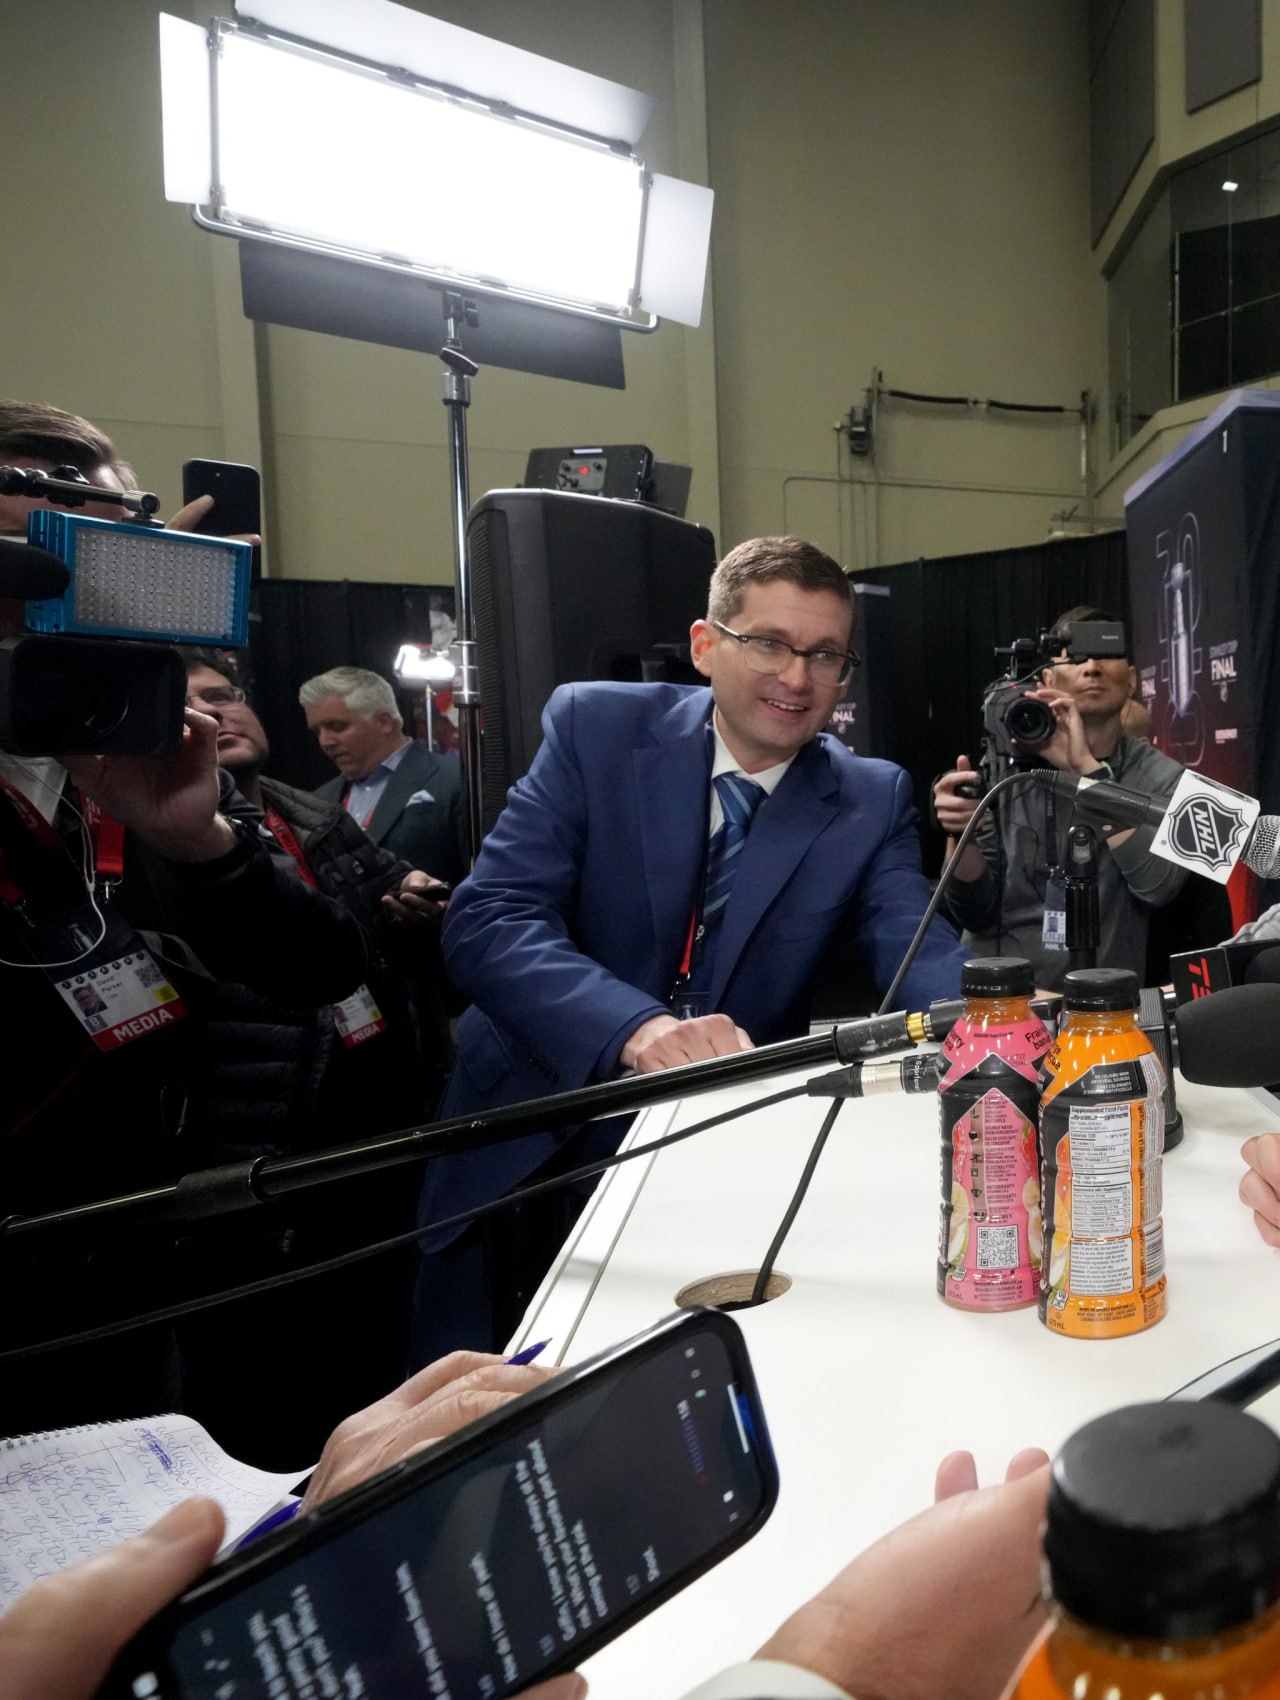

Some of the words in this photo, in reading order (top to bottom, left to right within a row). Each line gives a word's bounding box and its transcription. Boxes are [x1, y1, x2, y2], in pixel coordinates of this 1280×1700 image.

[1211, 655, 1237, 681] FINAL
[1193, 807, 1216, 853] NHL
[112, 1008, 175, 1042] MEDIA
[351, 1022, 381, 1044] MEDIA
